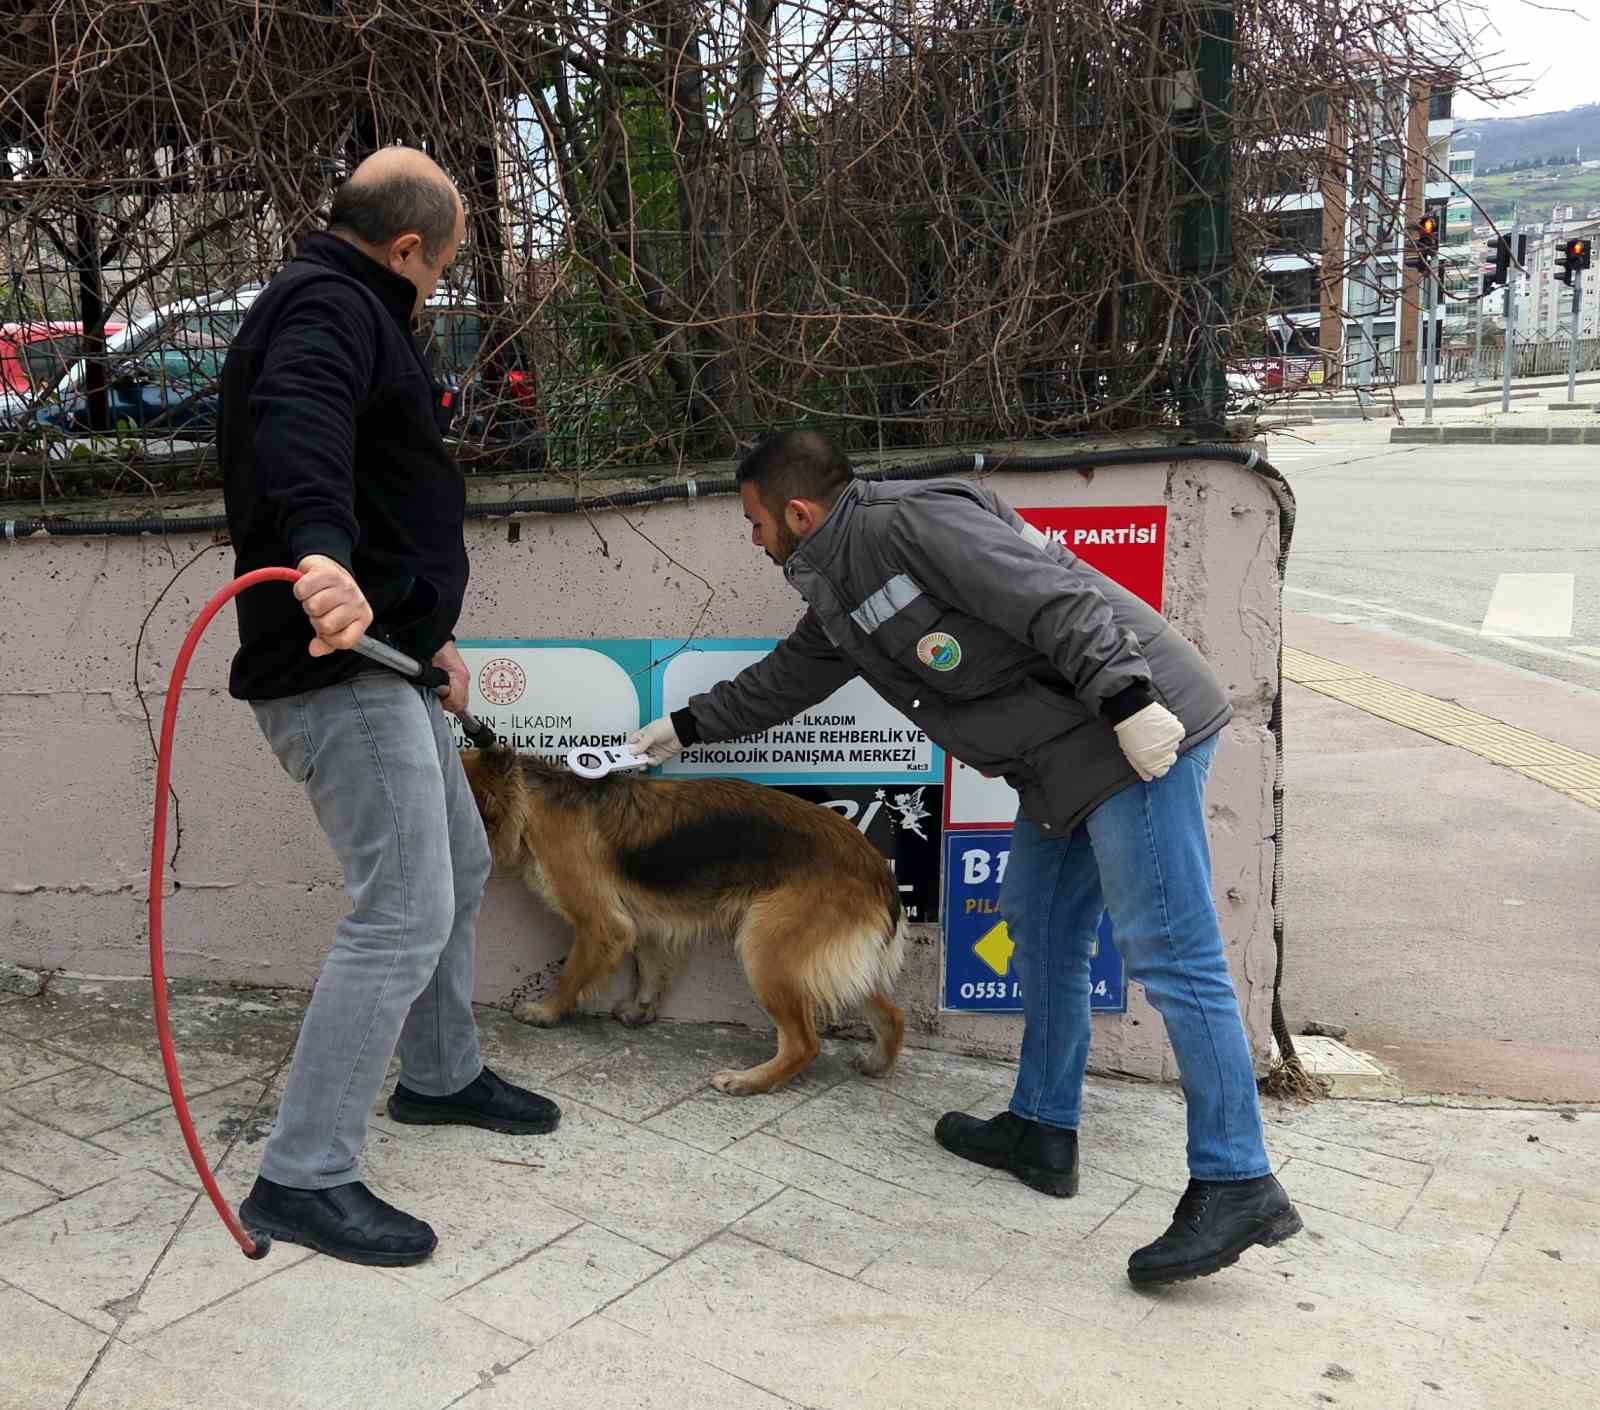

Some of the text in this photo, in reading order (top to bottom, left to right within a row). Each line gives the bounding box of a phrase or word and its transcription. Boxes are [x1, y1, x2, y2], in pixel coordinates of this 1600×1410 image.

[1073, 523, 1158, 545] PARTİSİ
[511, 711, 573, 729] İLKADIM
[803, 712, 857, 727] İLKADIM
[511, 732, 536, 748] İLK
[539, 732, 555, 748] İZ
[557, 731, 628, 748] AKADEMİ
[772, 731, 817, 744] HANE
[819, 727, 904, 744] REHBERLİK
[905, 729, 927, 743] VE
[679, 745, 917, 766] PSİKOLOJİK DANIŞMA MERKEZİ
[960, 982, 1008, 999] 0553
